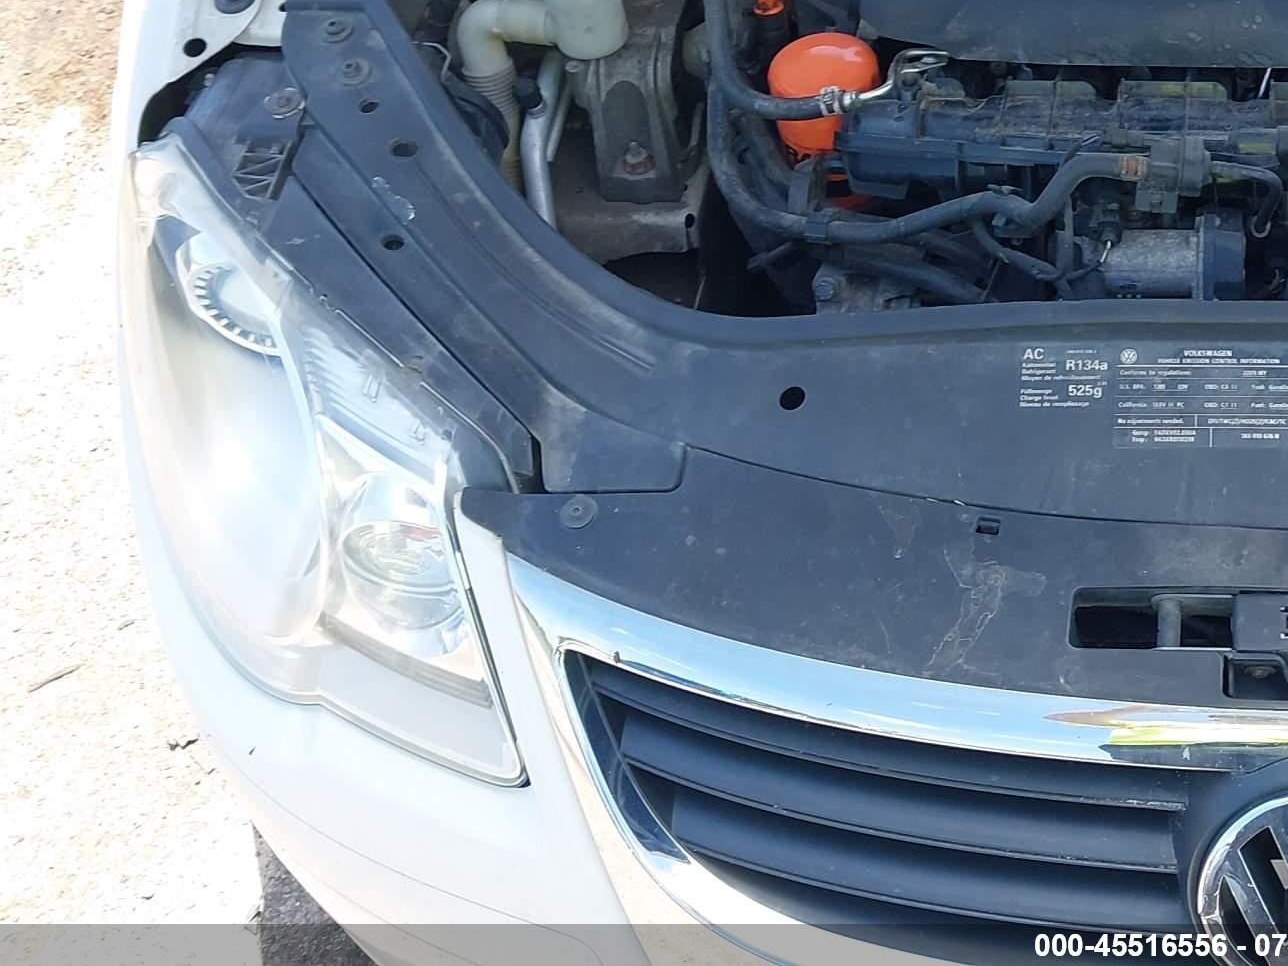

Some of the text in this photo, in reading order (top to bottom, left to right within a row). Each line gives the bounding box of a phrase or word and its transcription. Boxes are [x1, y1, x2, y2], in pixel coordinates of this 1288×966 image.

[1023, 348, 1045, 360] AC
[1183, 349, 1233, 357] VOLKSWAGEN
[1065, 359, 1108, 371] R134a
[1068, 384, 1103, 398] 525g
